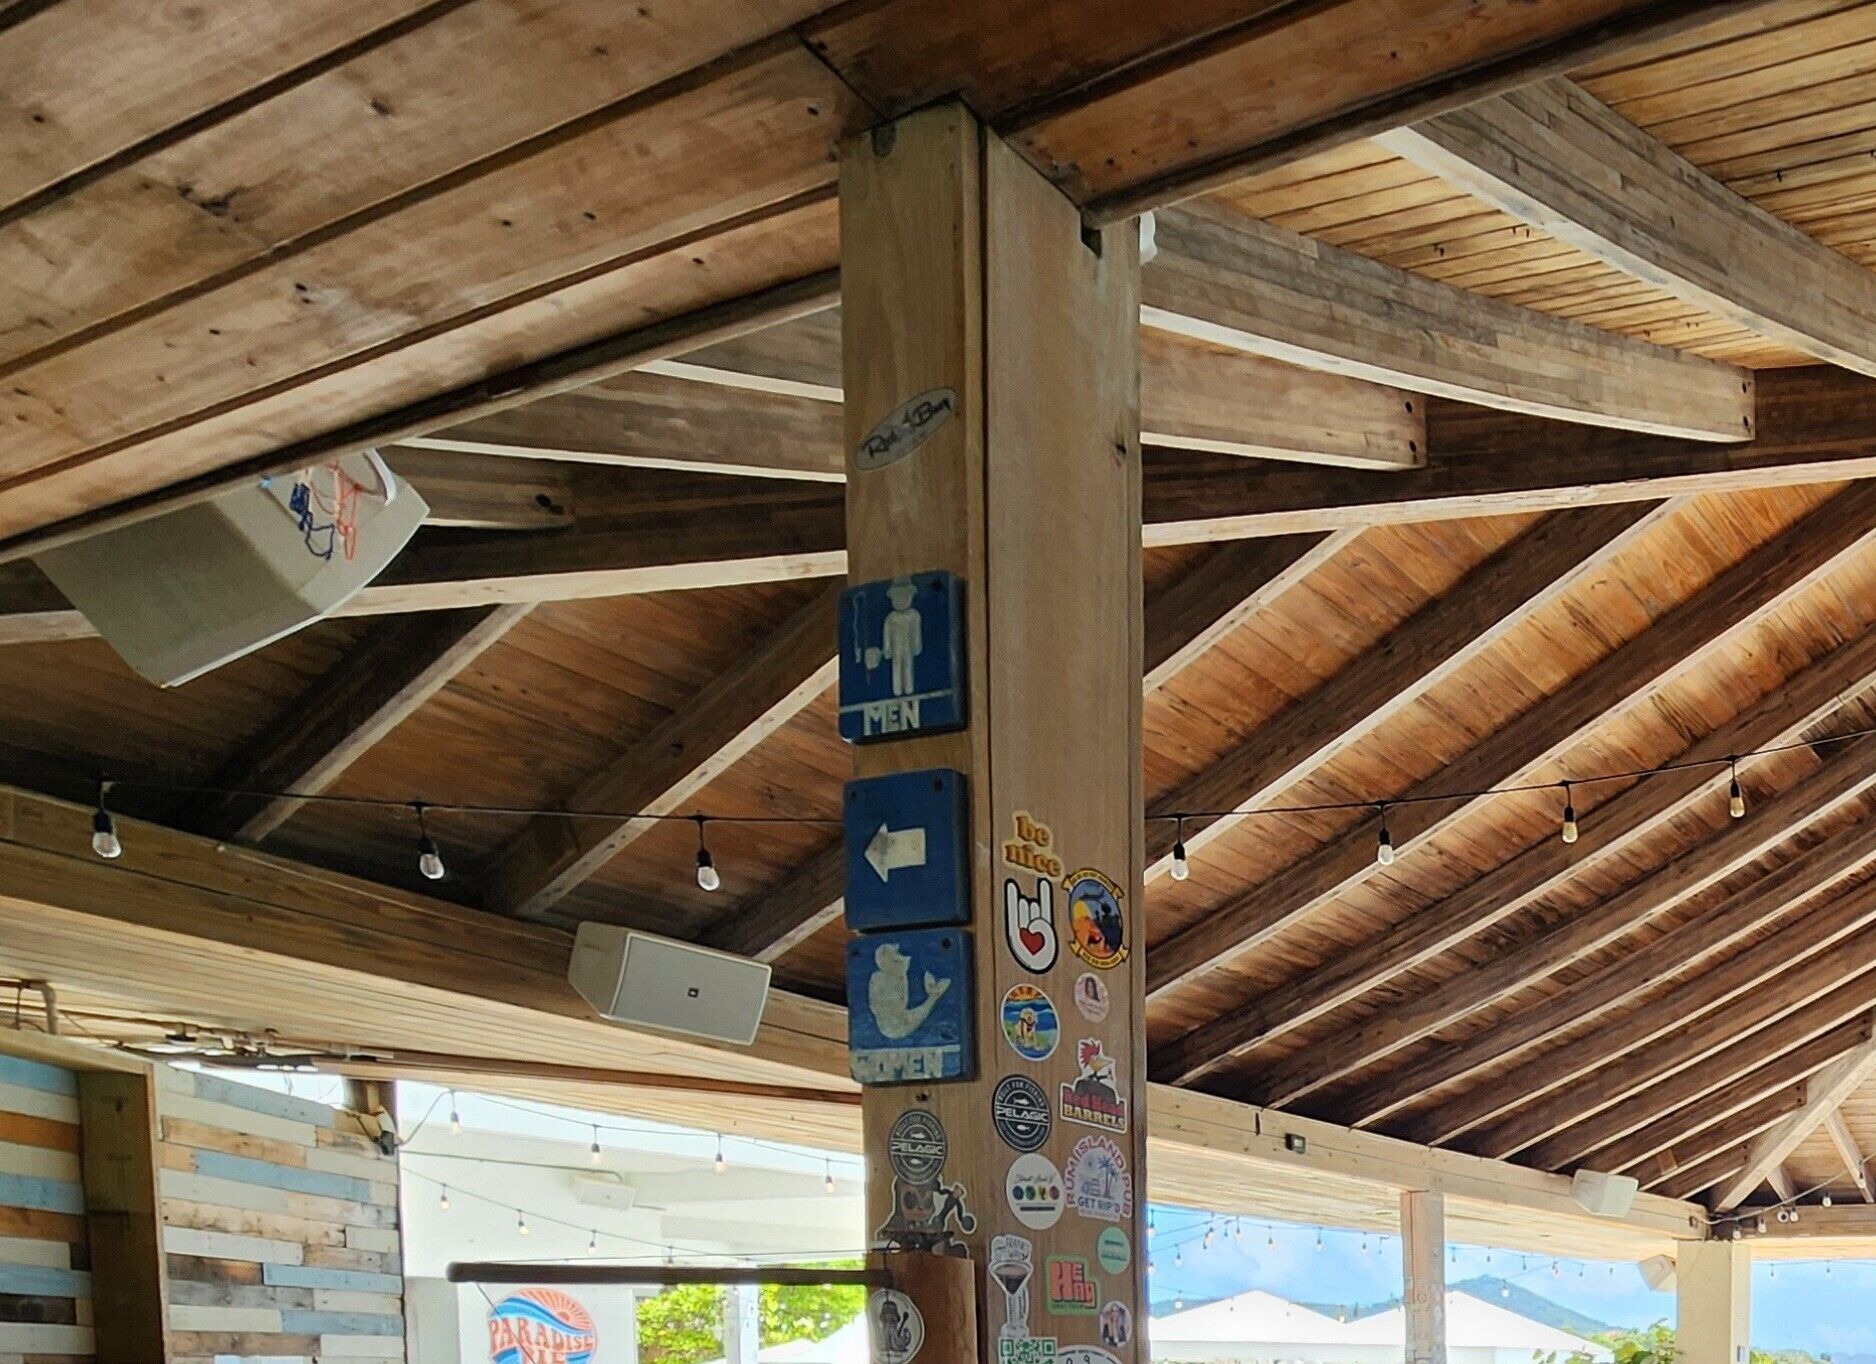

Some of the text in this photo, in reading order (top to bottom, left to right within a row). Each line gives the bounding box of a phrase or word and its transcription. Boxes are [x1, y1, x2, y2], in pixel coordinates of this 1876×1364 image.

[863, 700, 920, 736] MEN
[1016, 815, 1050, 847] be
[1004, 843, 1061, 877] nice
[996, 1105, 1049, 1122] PELAGIC
[1063, 1104, 1125, 1127] BARRELS
[891, 1141, 943, 1155] PELAGIC
[1066, 1160, 1078, 1205] RUM
[1076, 1137, 1125, 1169] ISLAND
[1122, 1175, 1131, 1216] PUB
[1078, 1196, 1095, 1209] GET
[489, 1317, 594, 1352] PARADISE
